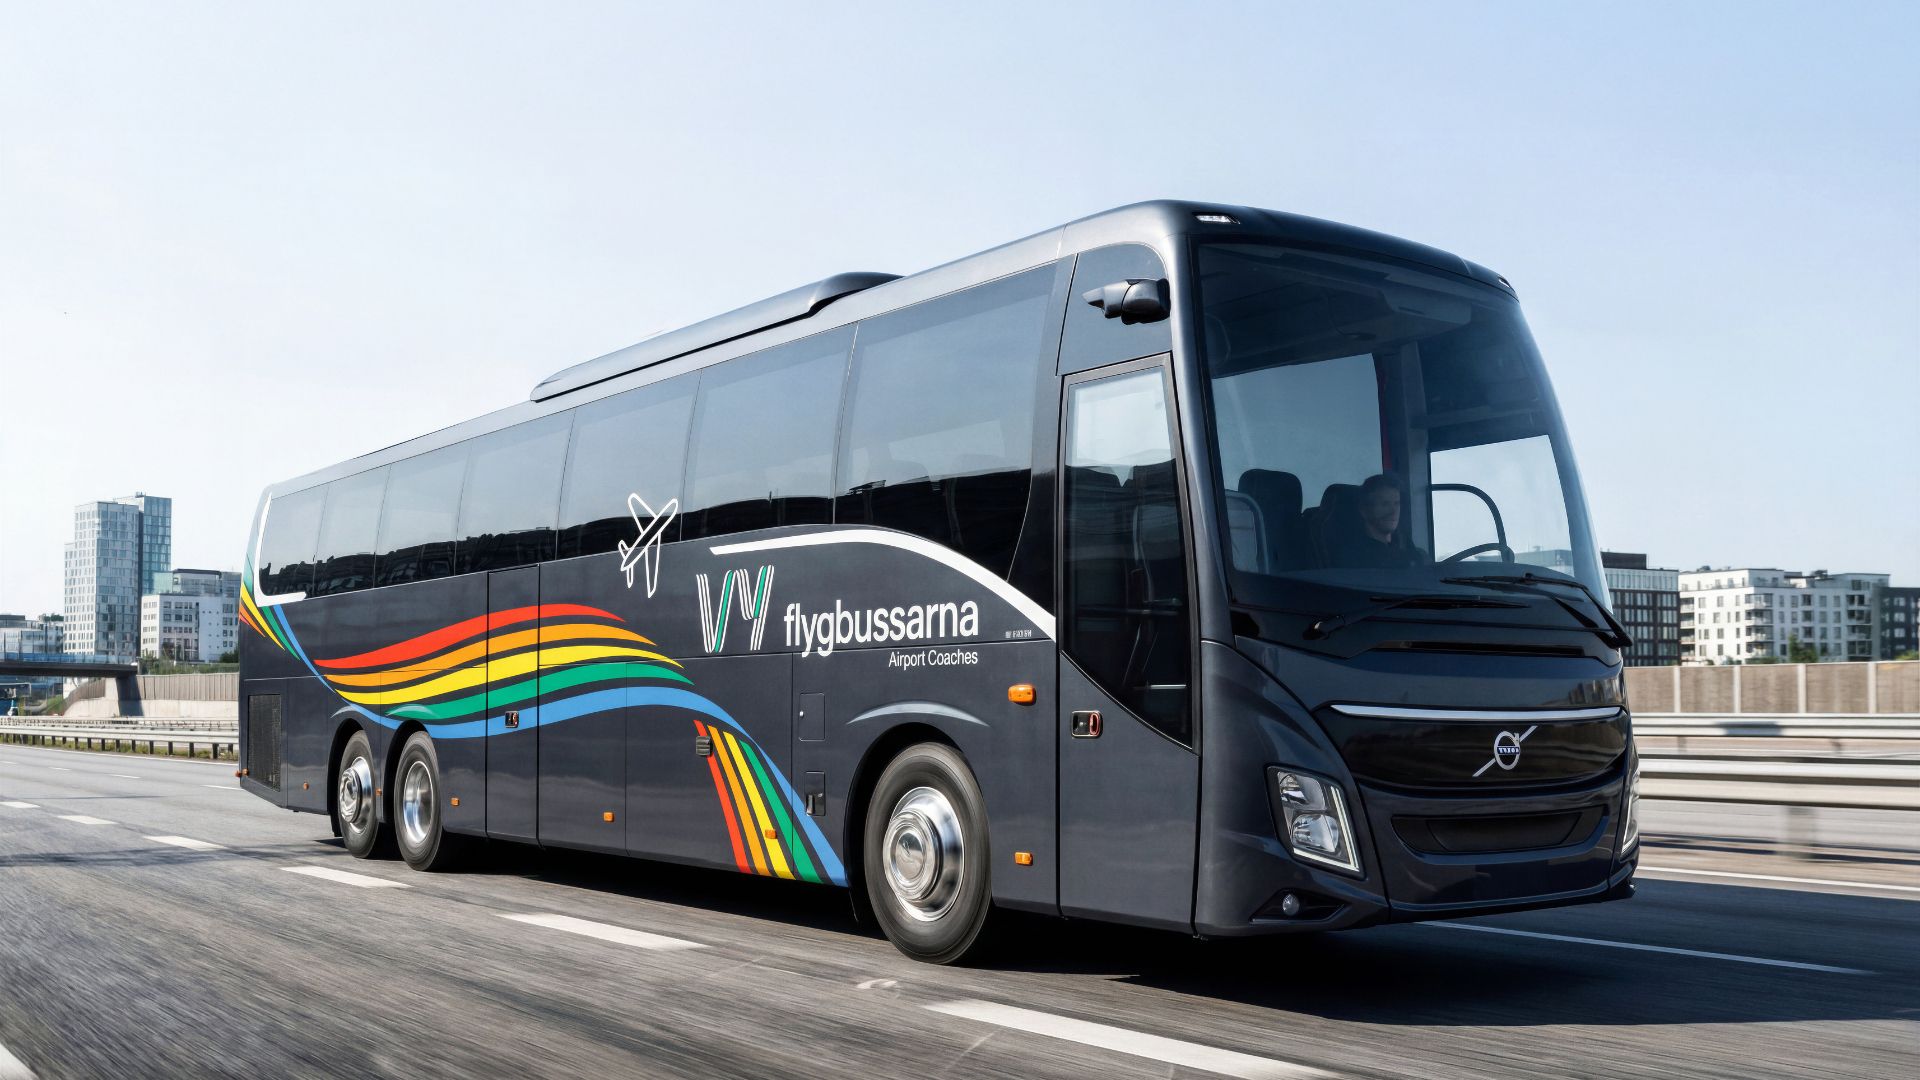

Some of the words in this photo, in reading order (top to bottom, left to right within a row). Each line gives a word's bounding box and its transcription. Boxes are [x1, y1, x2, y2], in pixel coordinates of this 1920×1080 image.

[783, 599, 979, 658] flygbussarna
[888, 650, 926, 671] Airport
[928, 649, 978, 666] Coaches
